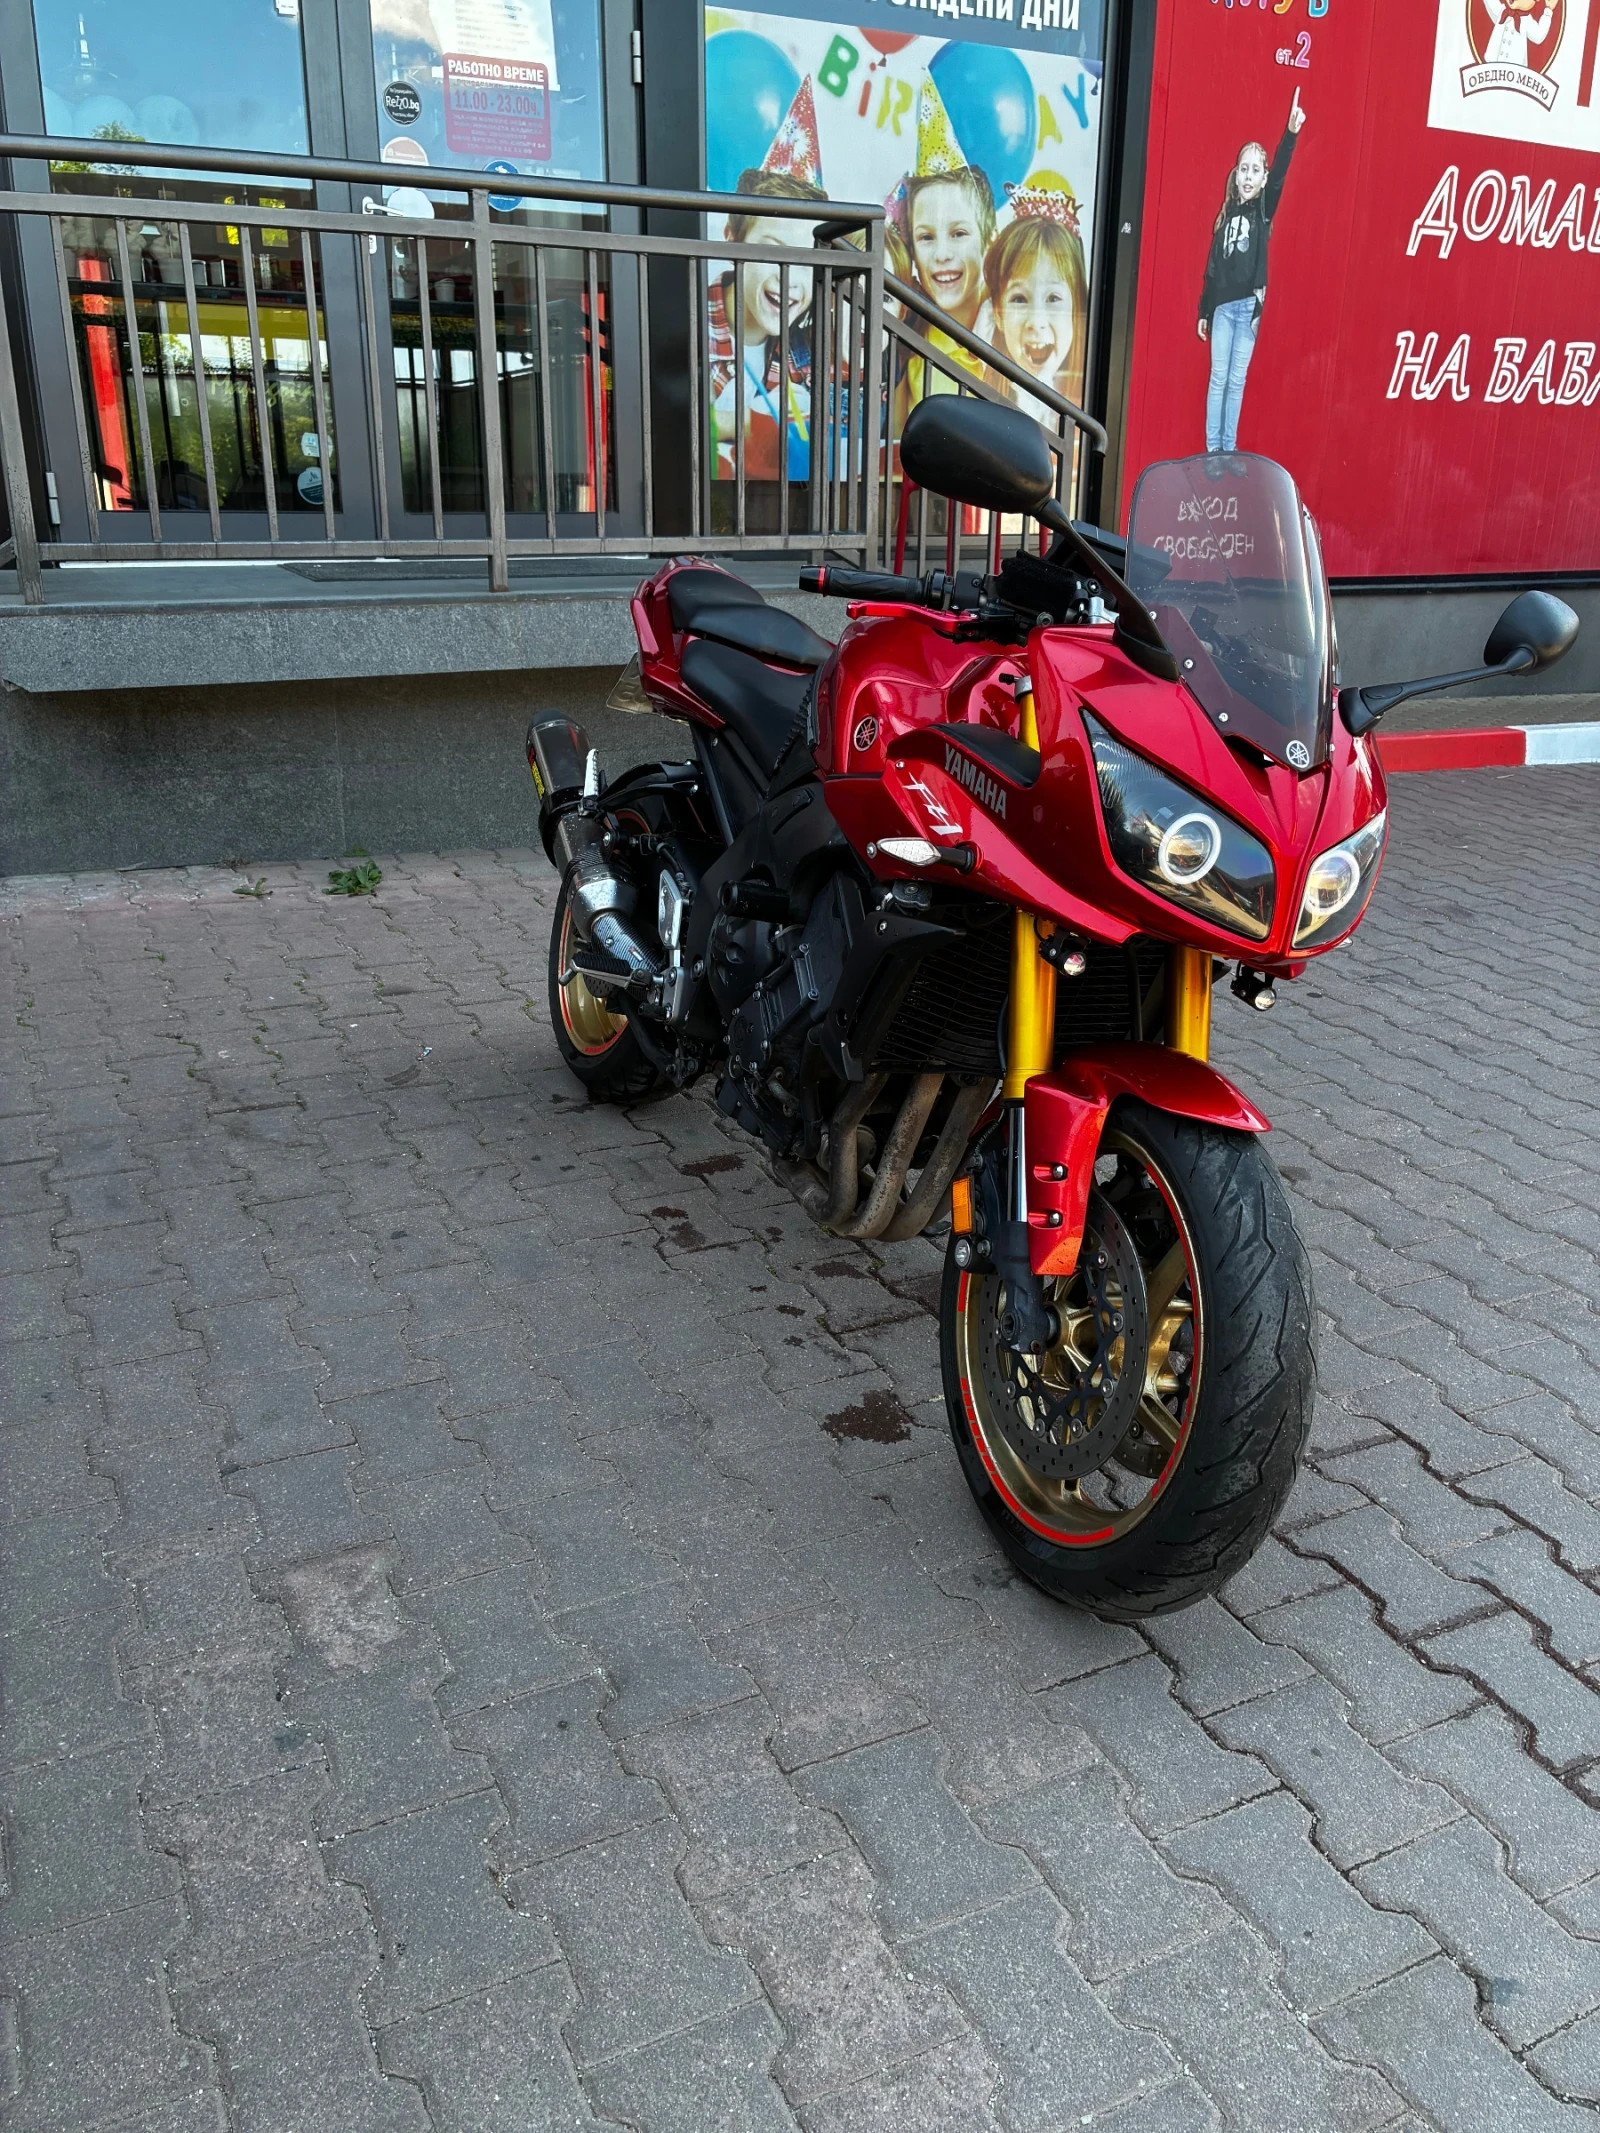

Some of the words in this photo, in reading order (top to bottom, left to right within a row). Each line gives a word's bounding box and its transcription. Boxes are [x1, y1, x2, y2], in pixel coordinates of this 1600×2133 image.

[1021, 0, 1080, 31] ДНИ
[447, 59, 501, 78] РАБОТНО
[503, 66, 544, 82] ВРЕМЕ
[1468, 69, 1515, 88] ОБЕДНО
[1516, 72, 1549, 100] МЕНЮ
[455, 89, 488, 110] 11.00
[1406, 165, 1600, 259] ДОМА
[1386, 331, 1470, 402] НА
[945, 743, 1007, 820] YAMAHA
